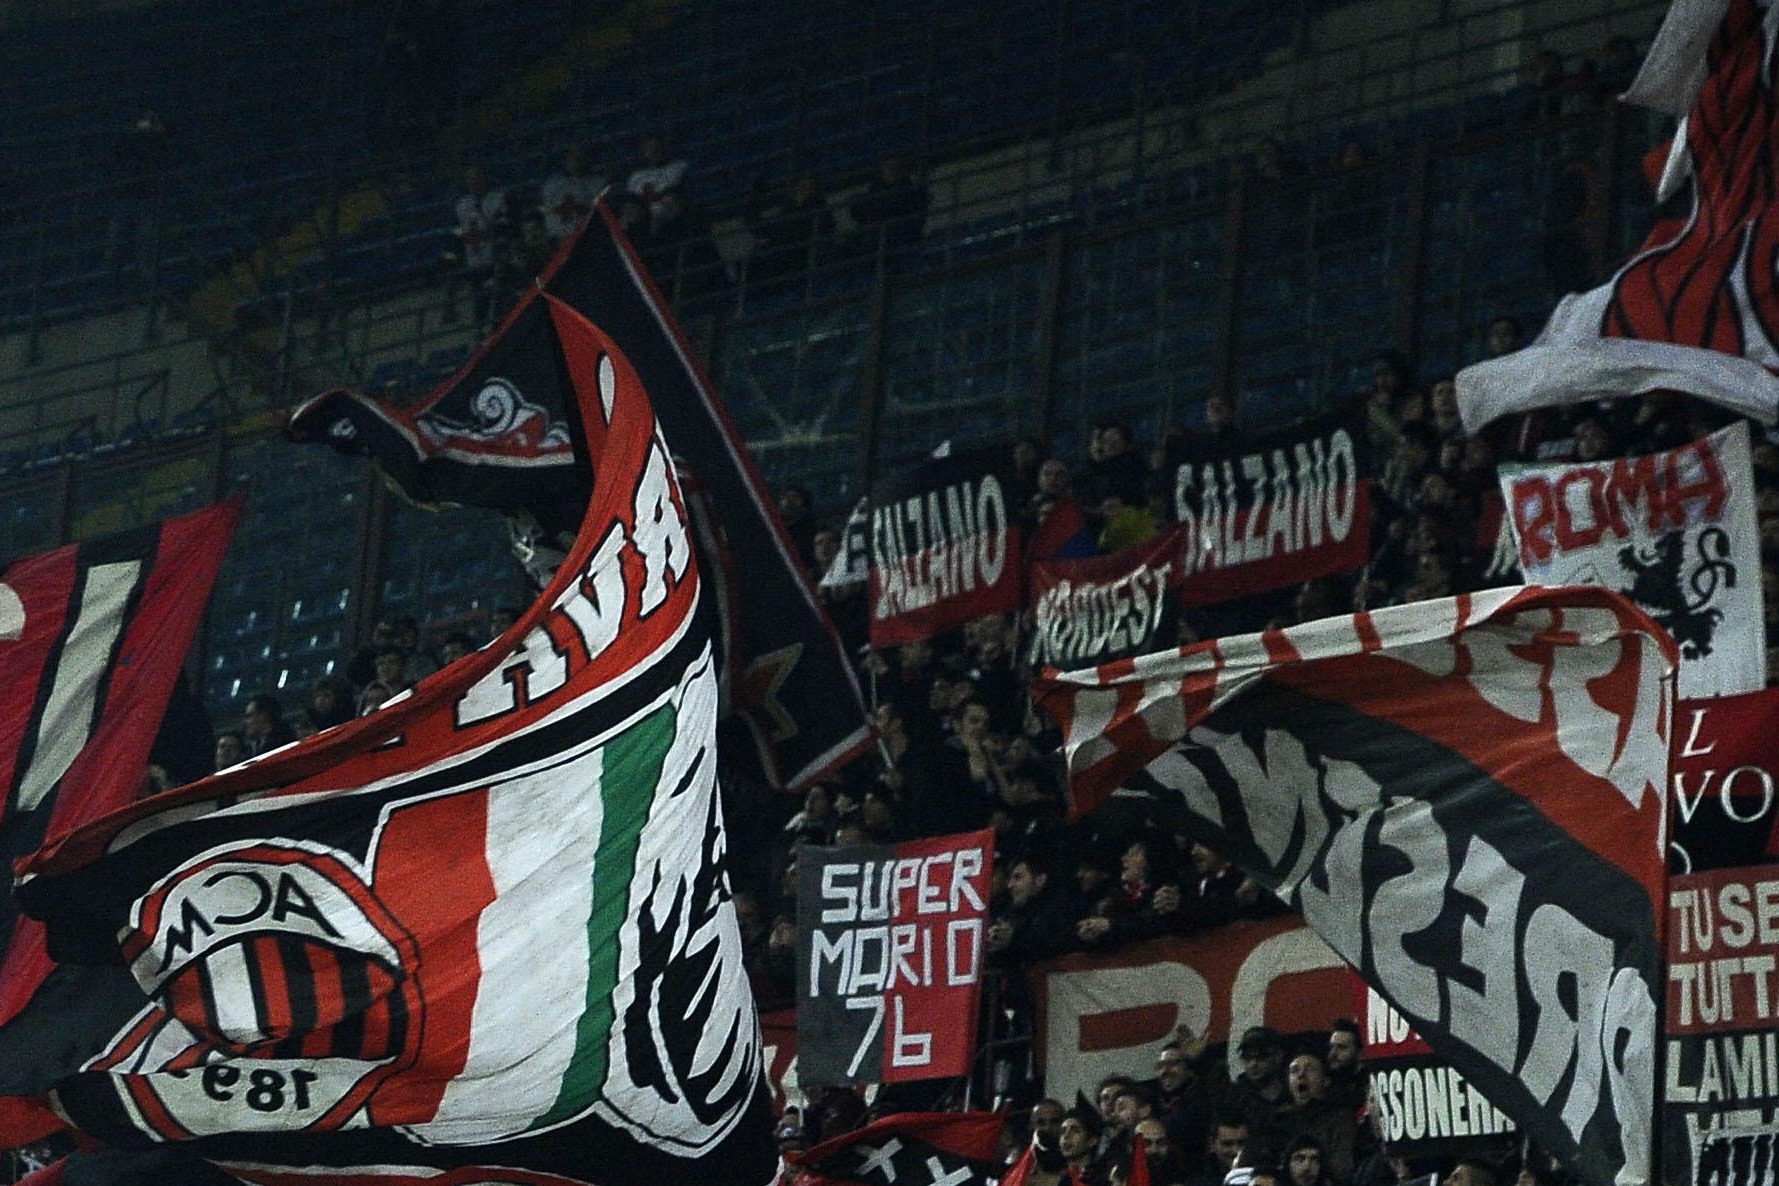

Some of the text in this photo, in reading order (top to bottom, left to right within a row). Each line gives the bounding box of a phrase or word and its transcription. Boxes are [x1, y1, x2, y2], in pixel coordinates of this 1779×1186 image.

[872, 473, 1009, 621] SALZANO
[1175, 427, 1357, 577] SALZANO
[1514, 438, 1727, 570] ROMA
[820, 848, 987, 923] SUPER
[1669, 953, 1779, 1027] TUTT
